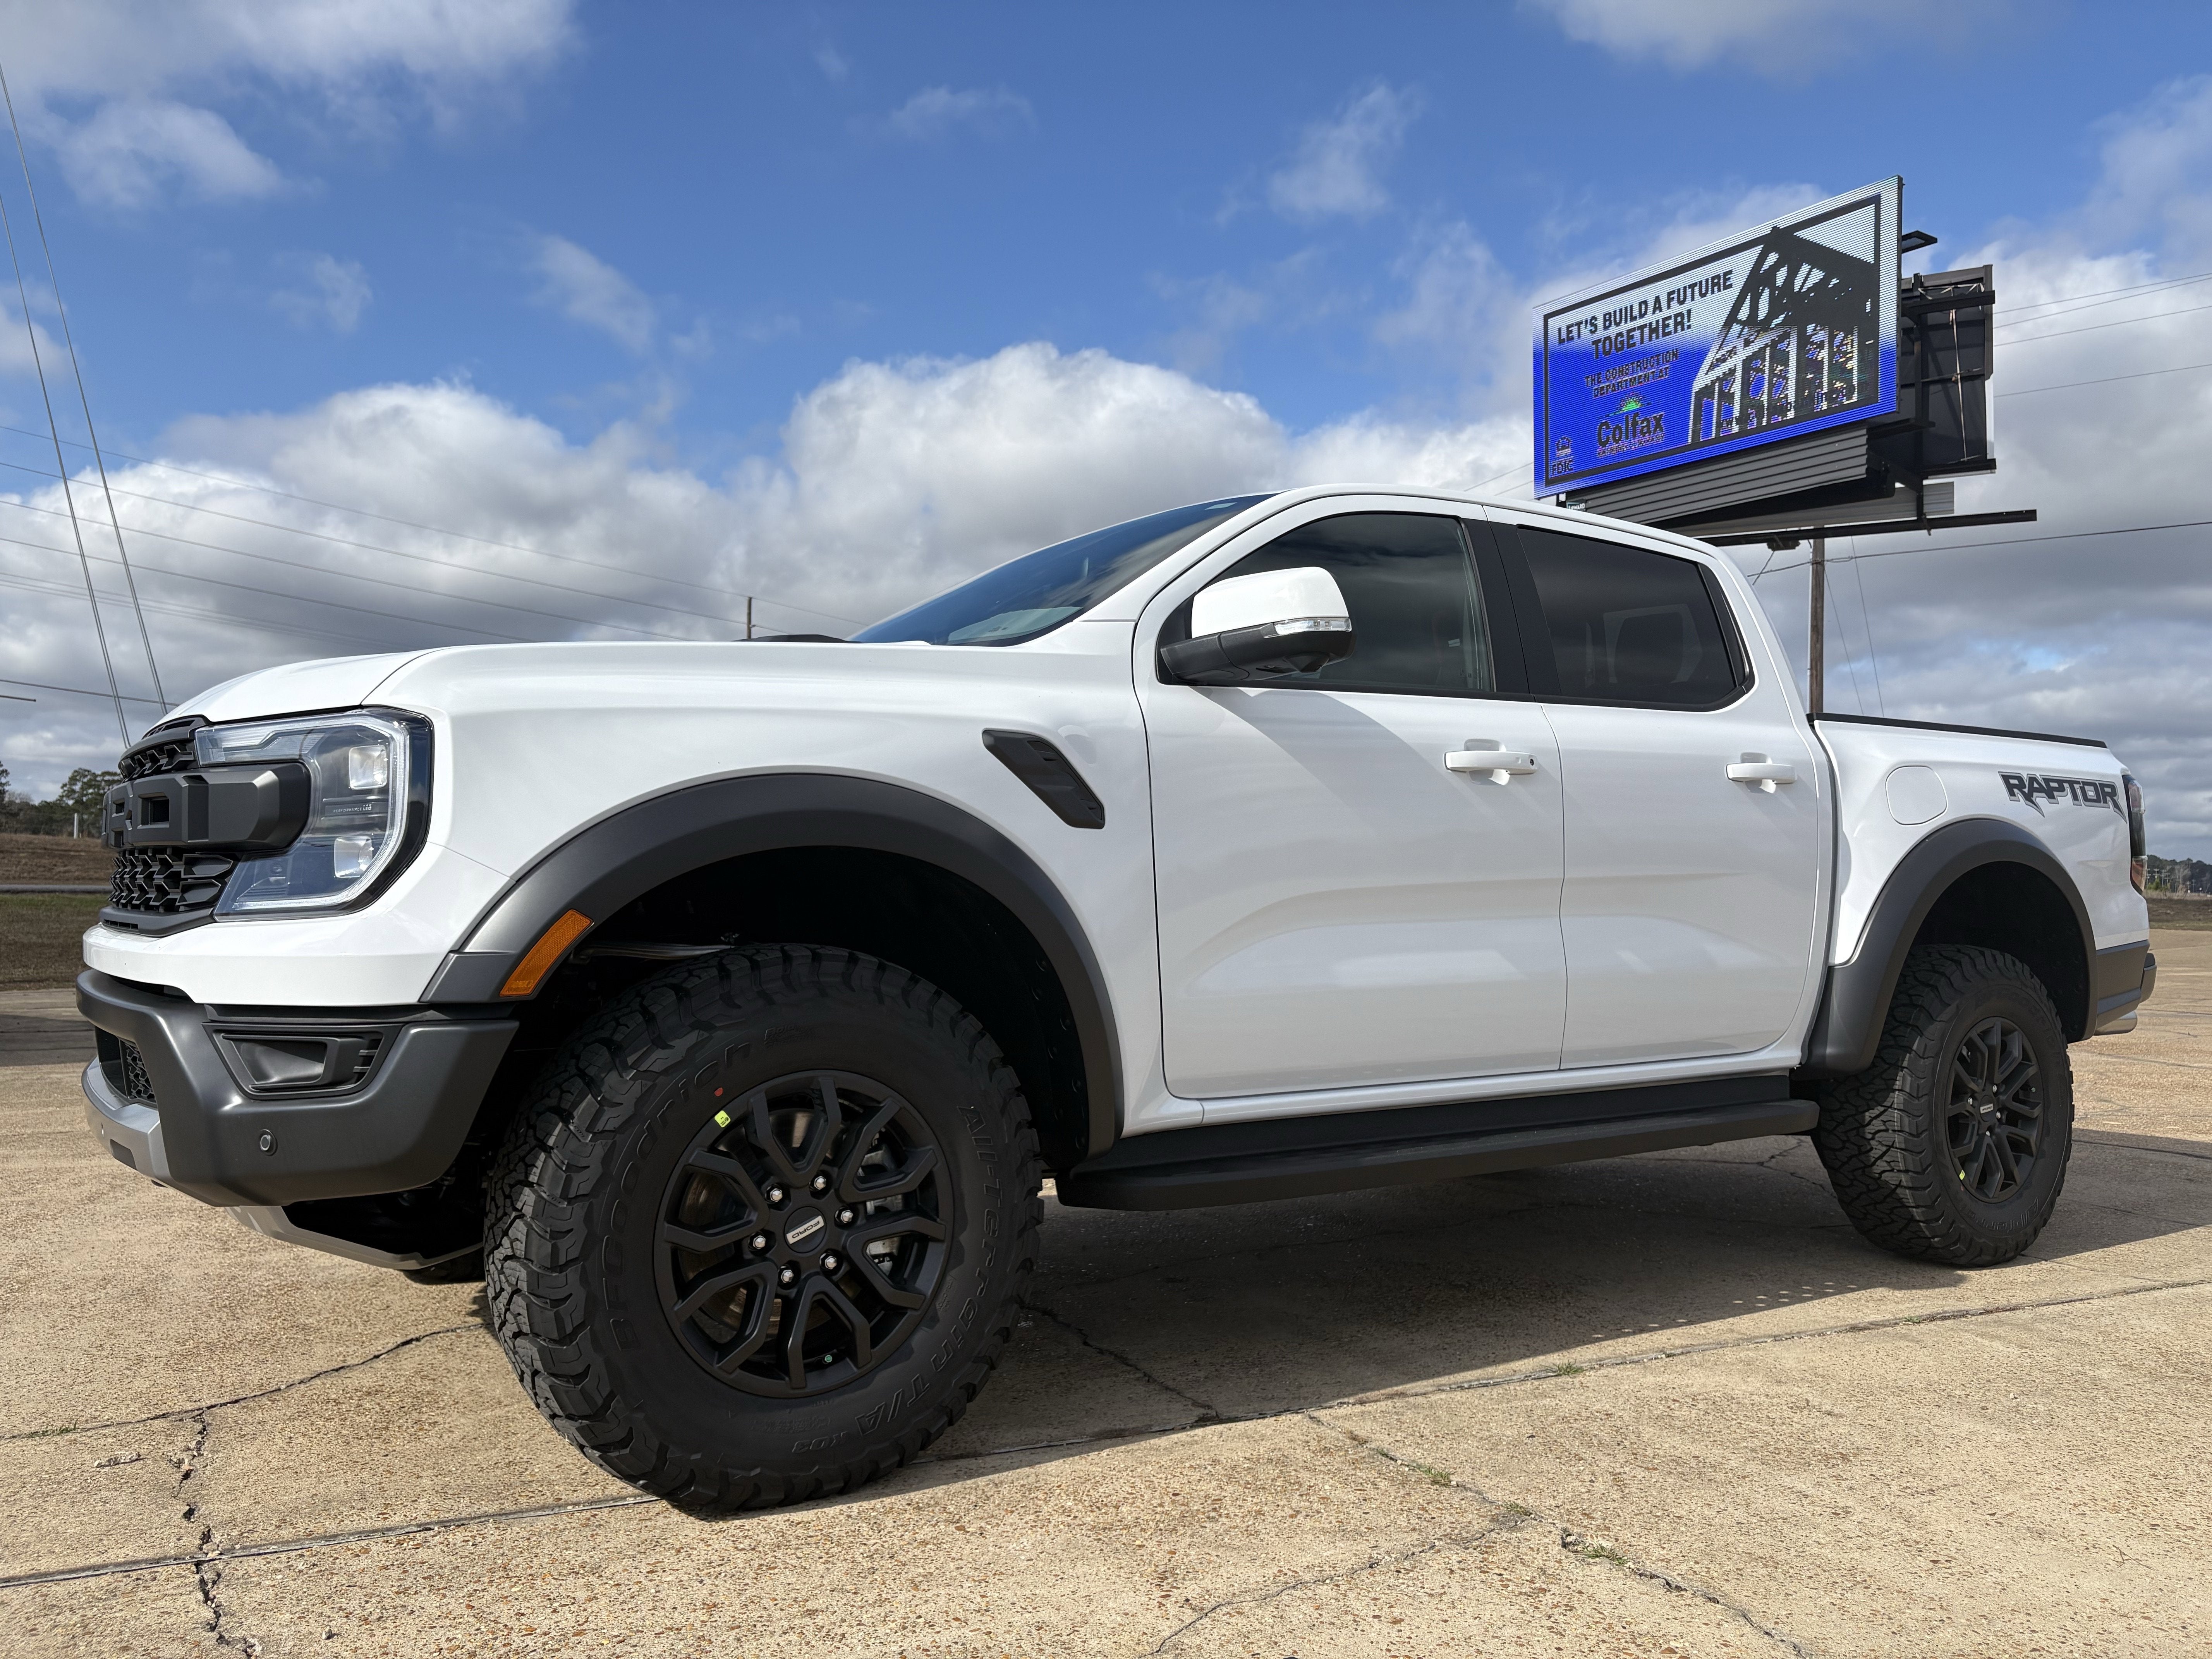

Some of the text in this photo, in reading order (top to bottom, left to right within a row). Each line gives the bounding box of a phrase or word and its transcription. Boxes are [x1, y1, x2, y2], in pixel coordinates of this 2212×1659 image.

[1558, 270, 1733, 345] LET'S BUILD A FUTURE
[1592, 309, 1692, 359] TOGETHER!
[1584, 348, 1679, 387] THE CONSTRUCTION
[1593, 366, 1670, 398] DEPARTMENT AT
[1597, 412, 1664, 447] Colfax
[1552, 459, 1574, 475] FDIC
[1998, 771, 2127, 824] RAPTOR
[792, 1220, 820, 1238] FORD
[855, 1374, 930, 1436] T/A
